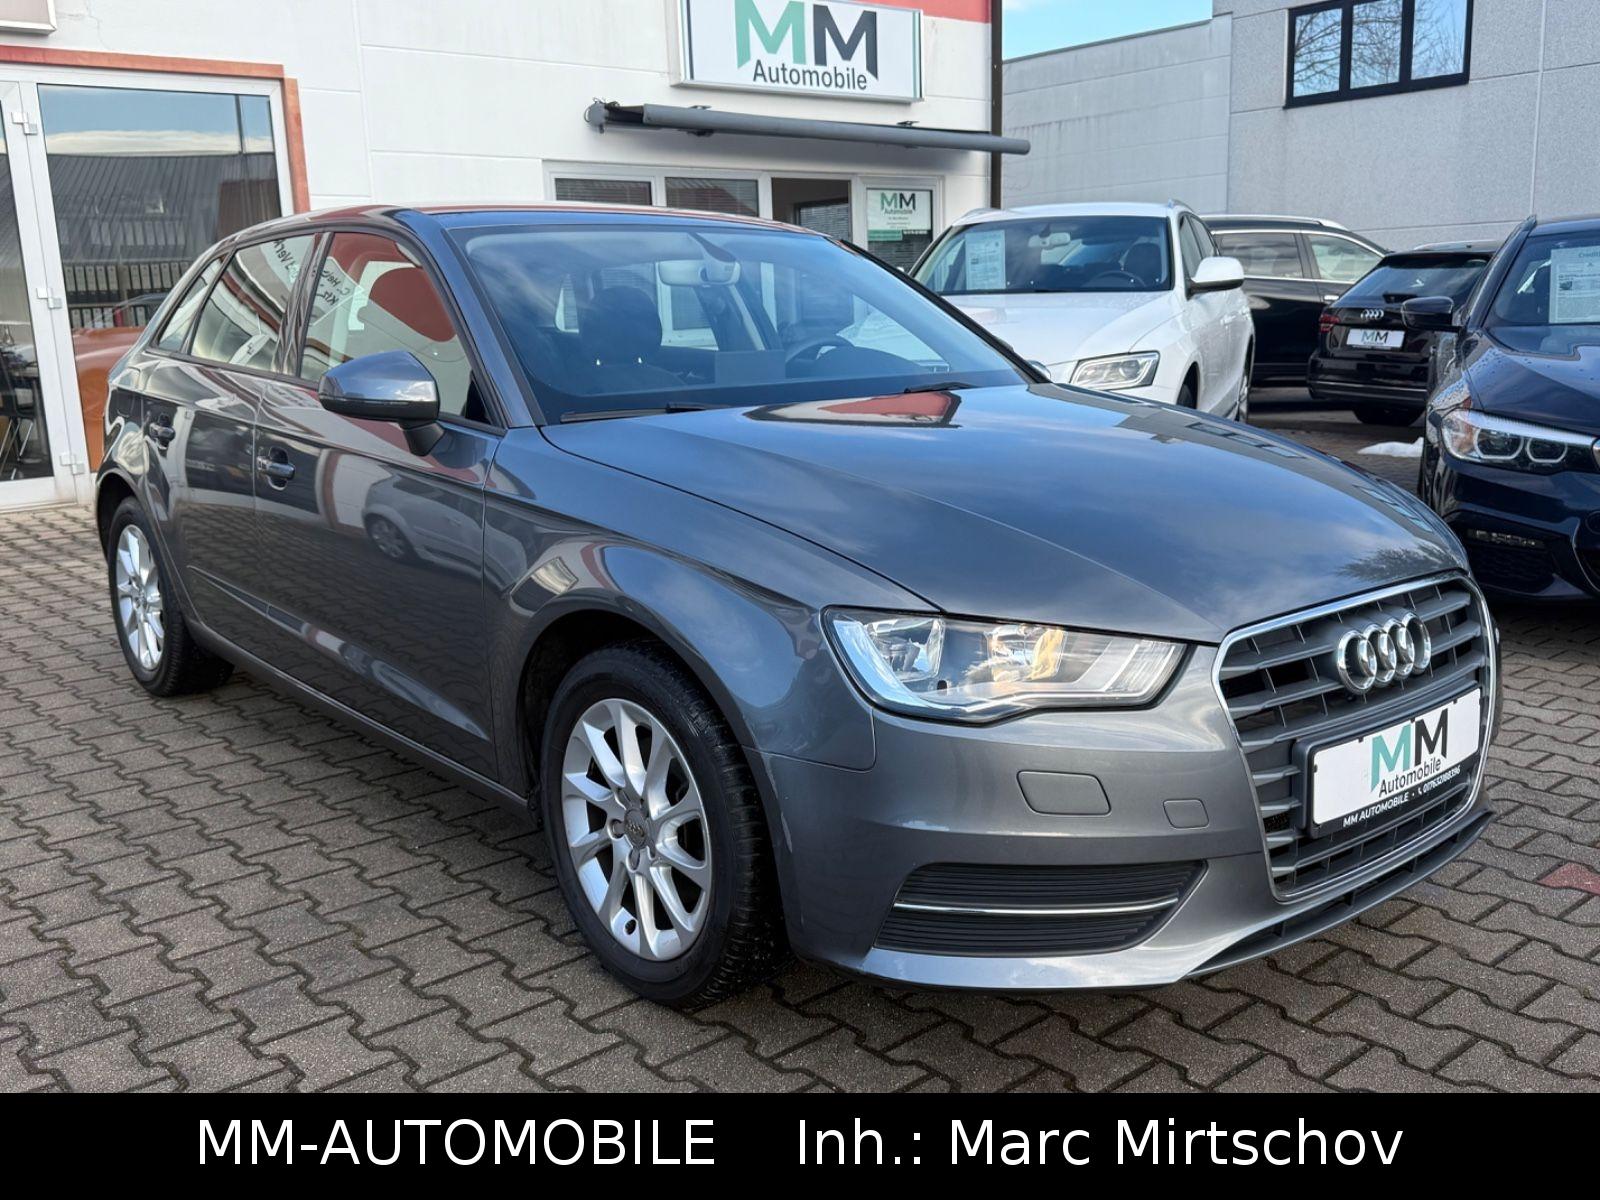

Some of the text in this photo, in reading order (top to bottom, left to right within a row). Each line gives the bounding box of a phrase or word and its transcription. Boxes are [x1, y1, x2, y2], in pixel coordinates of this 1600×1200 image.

[735, 0, 878, 80] MM
[753, 59, 867, 90] Automobile
[880, 192, 916, 211] MM
[1361, 330, 1389, 344] MM
[1371, 708, 1448, 792] MM
[1379, 757, 1442, 798] Automobile
[1343, 793, 1409, 828] MM AUTOMOBILE
